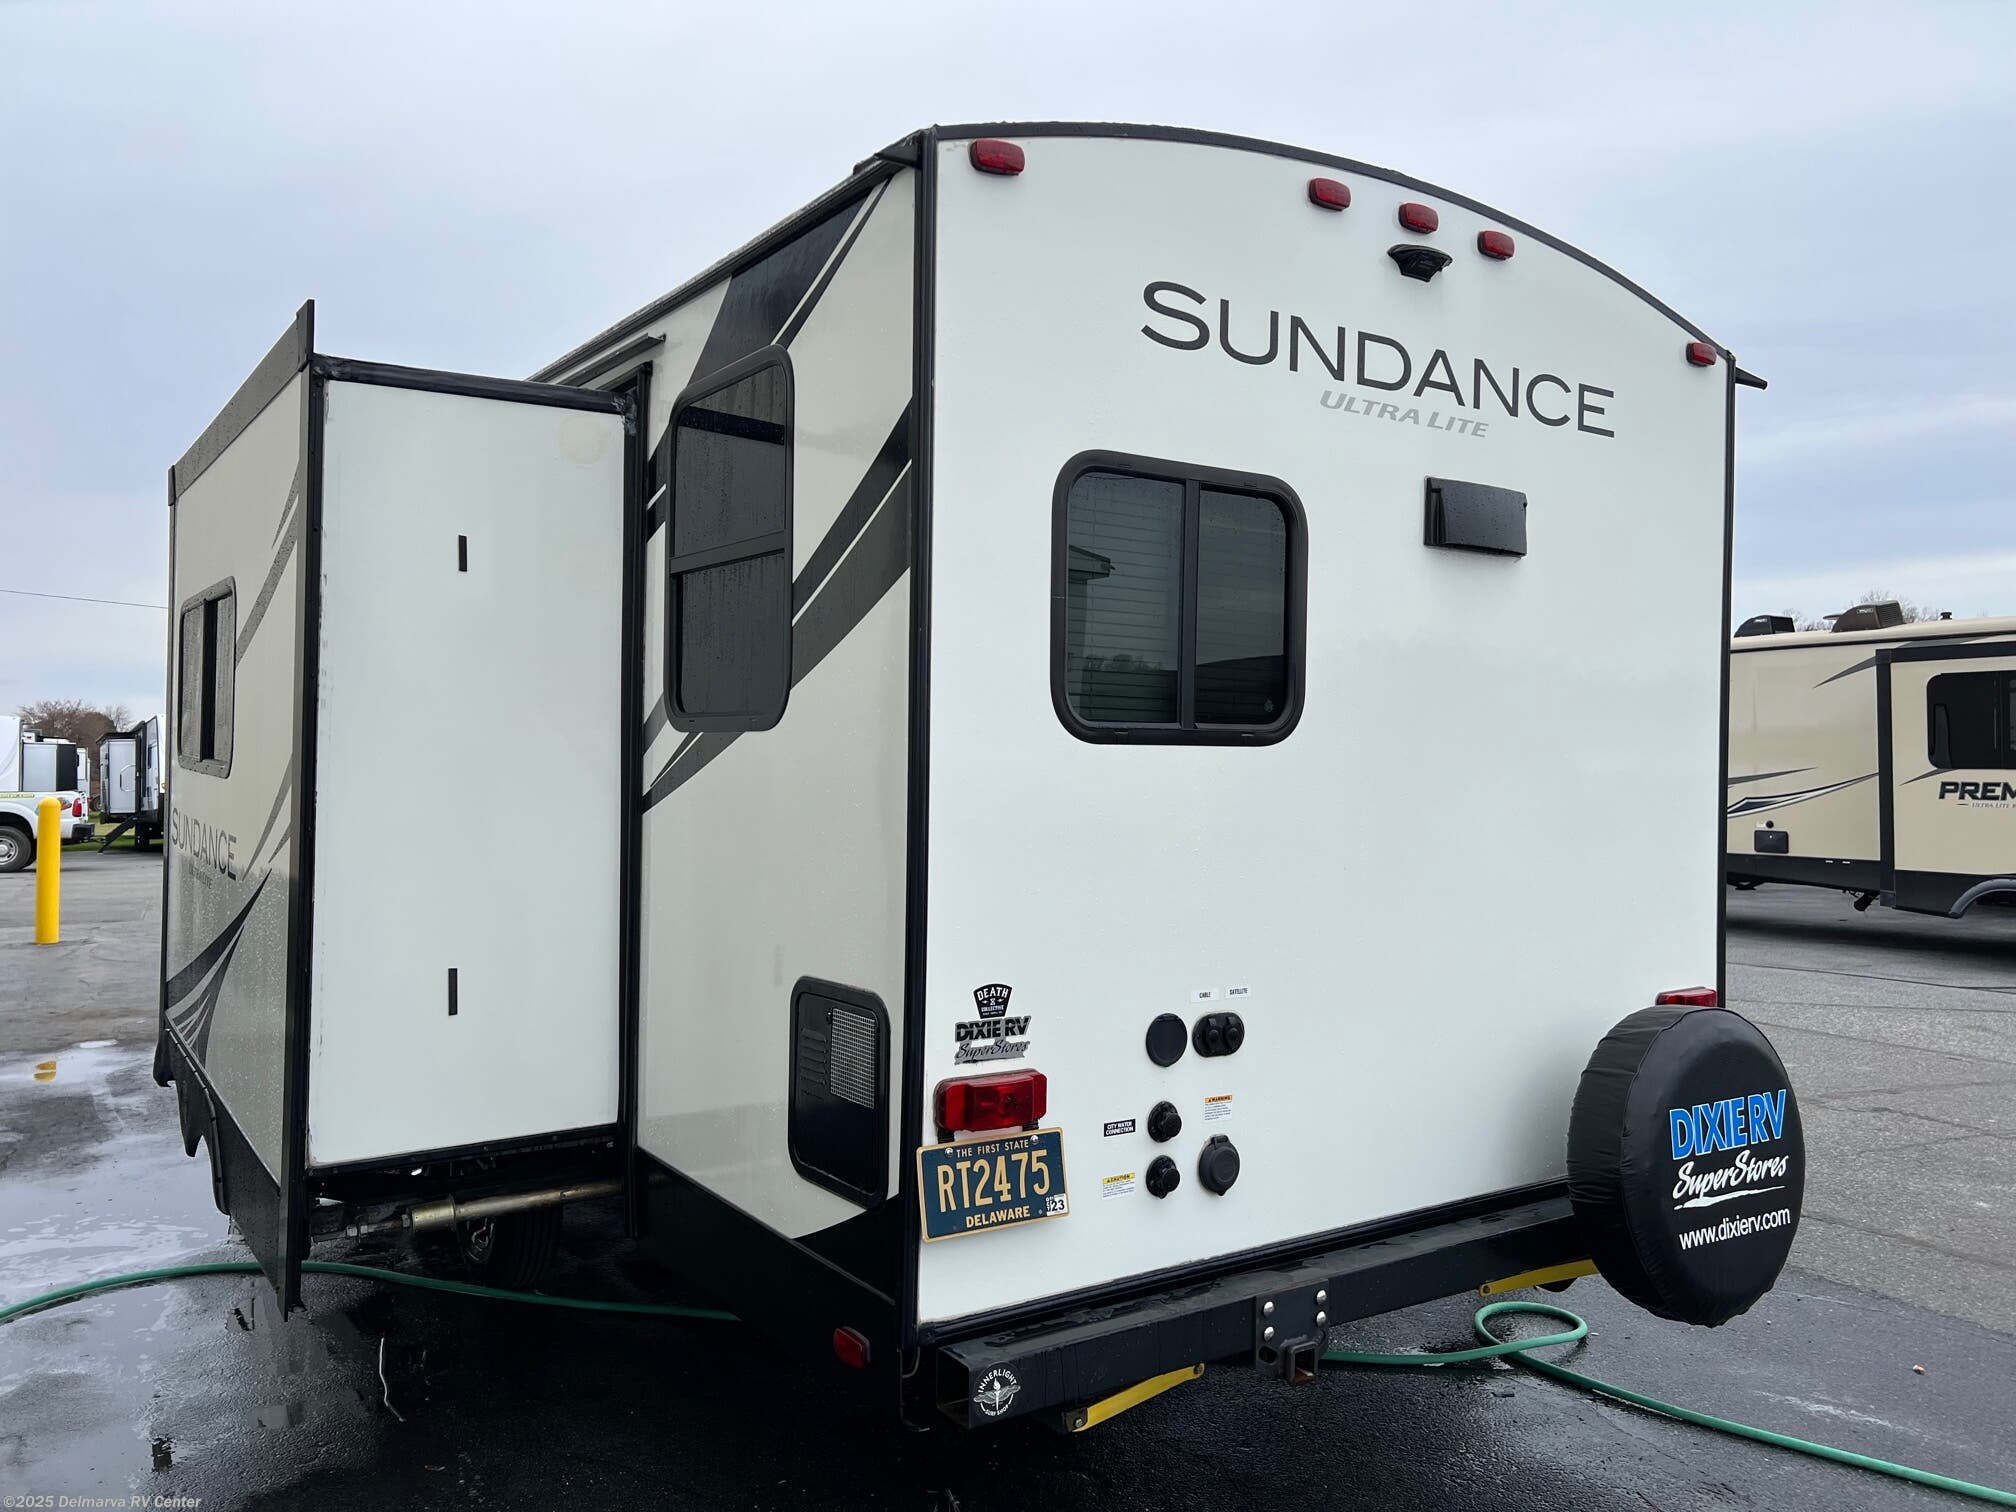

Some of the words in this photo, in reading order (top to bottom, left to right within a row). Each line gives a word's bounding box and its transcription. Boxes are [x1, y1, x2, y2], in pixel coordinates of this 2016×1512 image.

[1141, 281, 1615, 438] SUNDANCE
[1320, 390, 1421, 425] ULTRA
[1427, 411, 1489, 438] LITE
[172, 807, 237, 881] SUNDANCE
[977, 987, 1009, 1001] DEATH
[956, 1020, 1002, 1041] DIXIE
[1005, 1017, 1030, 1037] RV
[956, 1040, 1027, 1059] SuperStores
[1105, 1127, 1134, 1135] CONNECTION
[1669, 1097, 1746, 1160] DIXIE
[1747, 1089, 1787, 1145] RV
[956, 1148, 973, 1158] THE
[978, 1144, 1000, 1155] FIRST
[1004, 1139, 1029, 1150] STATE
[937, 1150, 1050, 1213] RT2475
[1672, 1150, 1789, 1199] SuperStores
[966, 1206, 1031, 1228] DELAWARE
[1051, 1199, 1065, 1212] 23
[1678, 1208, 1791, 1250] www.dixierv.com
[978, 1369, 1017, 1393] INNERLIGHT
